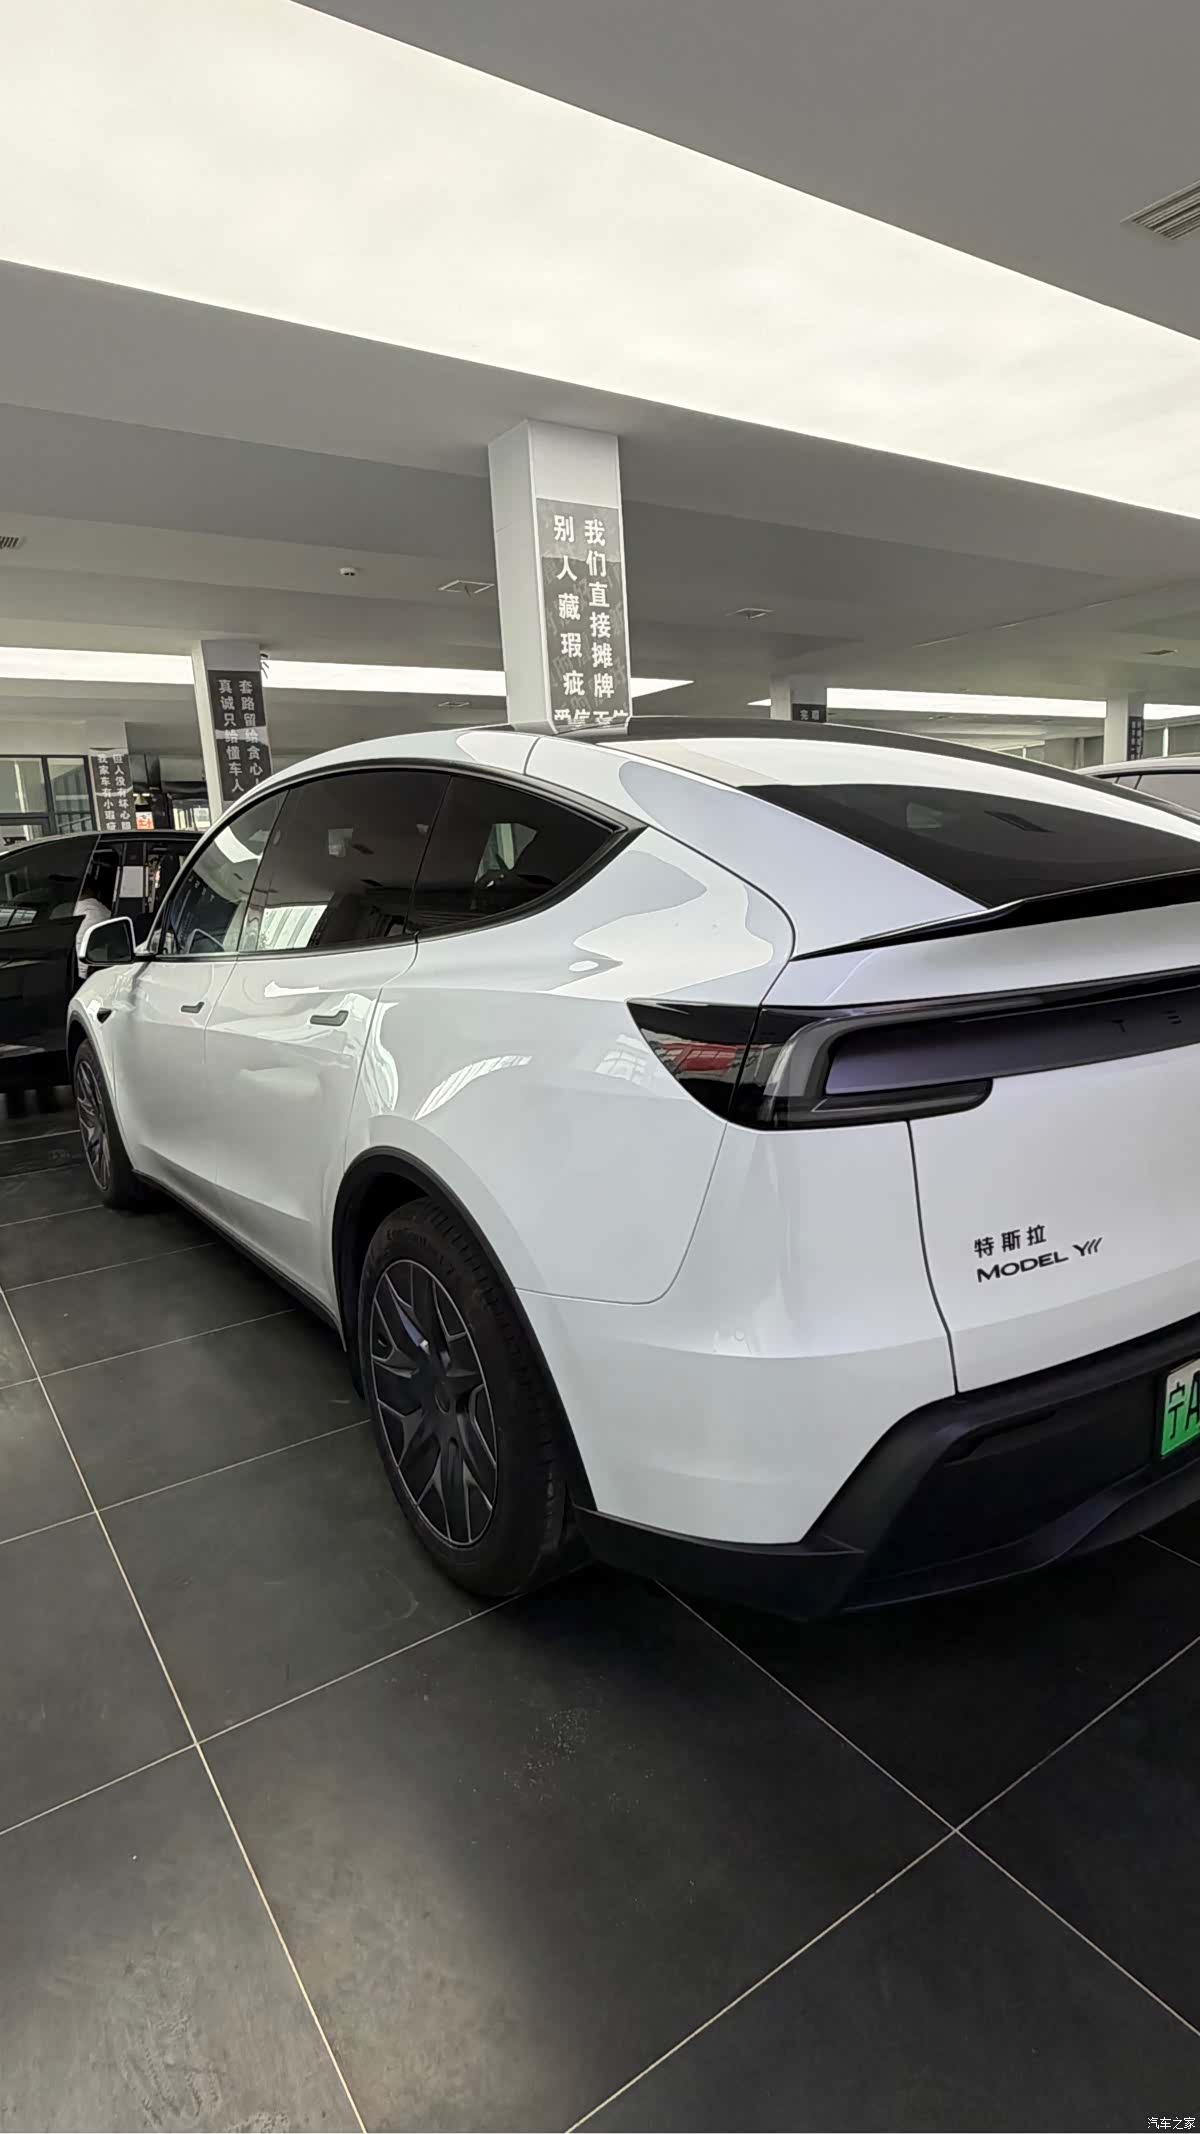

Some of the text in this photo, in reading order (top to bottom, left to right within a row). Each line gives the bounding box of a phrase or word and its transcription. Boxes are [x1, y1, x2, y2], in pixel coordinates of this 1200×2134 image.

[553, 514, 585, 697] 别人藏瑕疵
[584, 519, 615, 699] 我们直接摊牌
[218, 679, 245, 793] 真诚只给懂车人
[974, 1224, 1047, 1258] 特斯拉
[976, 1251, 1069, 1283] MODEL
